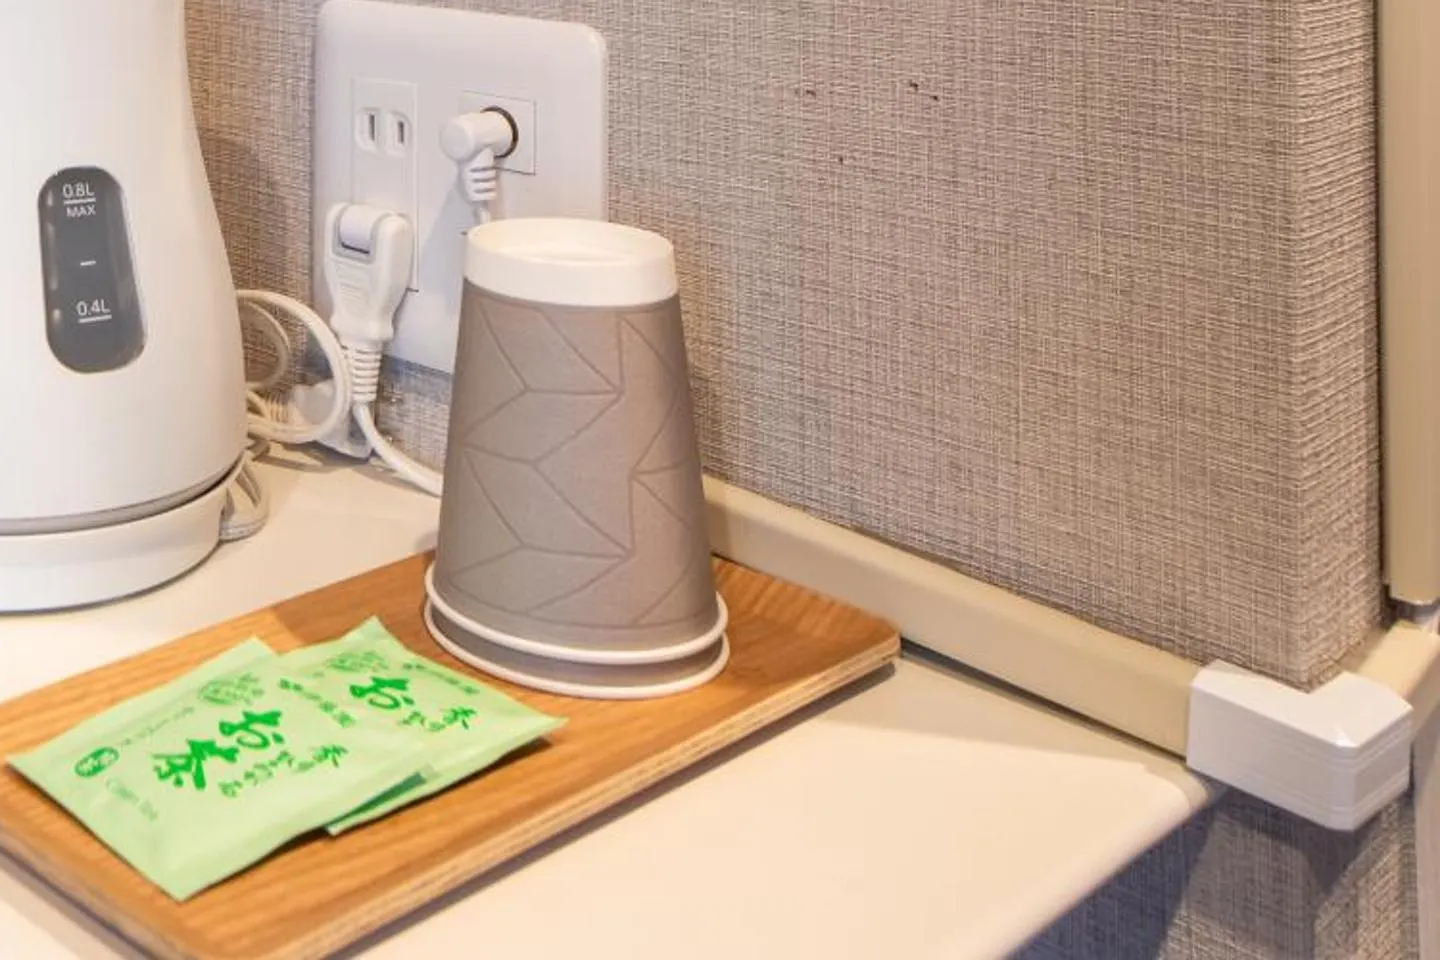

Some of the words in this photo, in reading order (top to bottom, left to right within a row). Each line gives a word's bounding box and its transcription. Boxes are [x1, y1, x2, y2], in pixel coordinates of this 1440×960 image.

[63, 182, 95, 199] 0.8L
[66, 204, 96, 218] MAX
[76, 299, 111, 317] 0.4L
[152, 709, 285, 791] お茶
